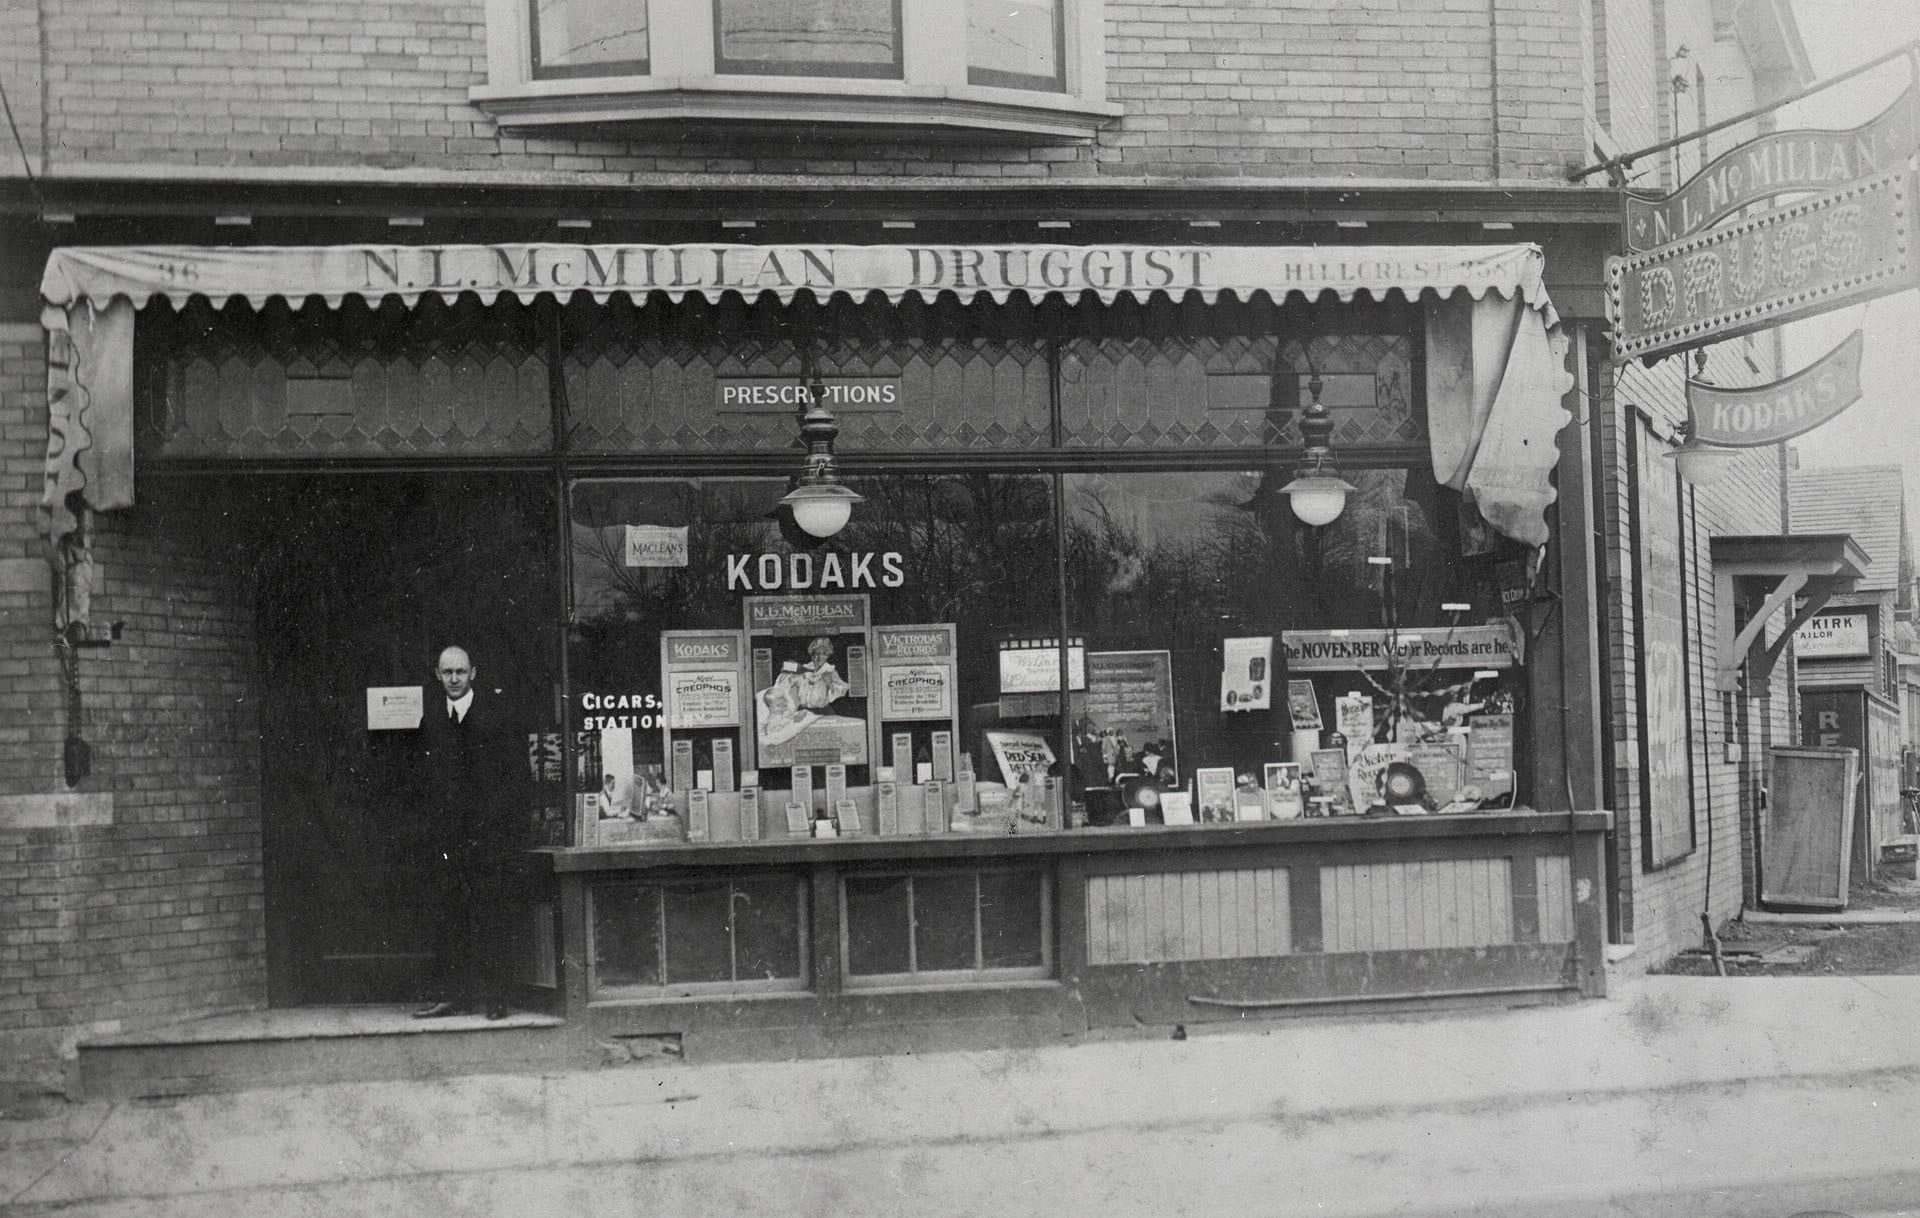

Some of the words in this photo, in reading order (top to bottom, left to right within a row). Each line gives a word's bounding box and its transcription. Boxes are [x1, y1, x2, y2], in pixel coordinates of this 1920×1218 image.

[910, 246, 1213, 289] DRUGGIST
[1284, 262, 1447, 281] HILLCREST
[1639, 204, 1864, 330] DRUGS
[1712, 374, 1836, 432] KODAKS
[727, 551, 905, 590] KODAKS
[1812, 617, 1853, 630] KIRK
[1796, 631, 1833, 640] AILOR
[674, 643, 729, 657] KODAKS
[1302, 642, 1380, 659] NOVEMBER
[1423, 640, 1469, 657] Records
[1471, 639, 1493, 655] are
